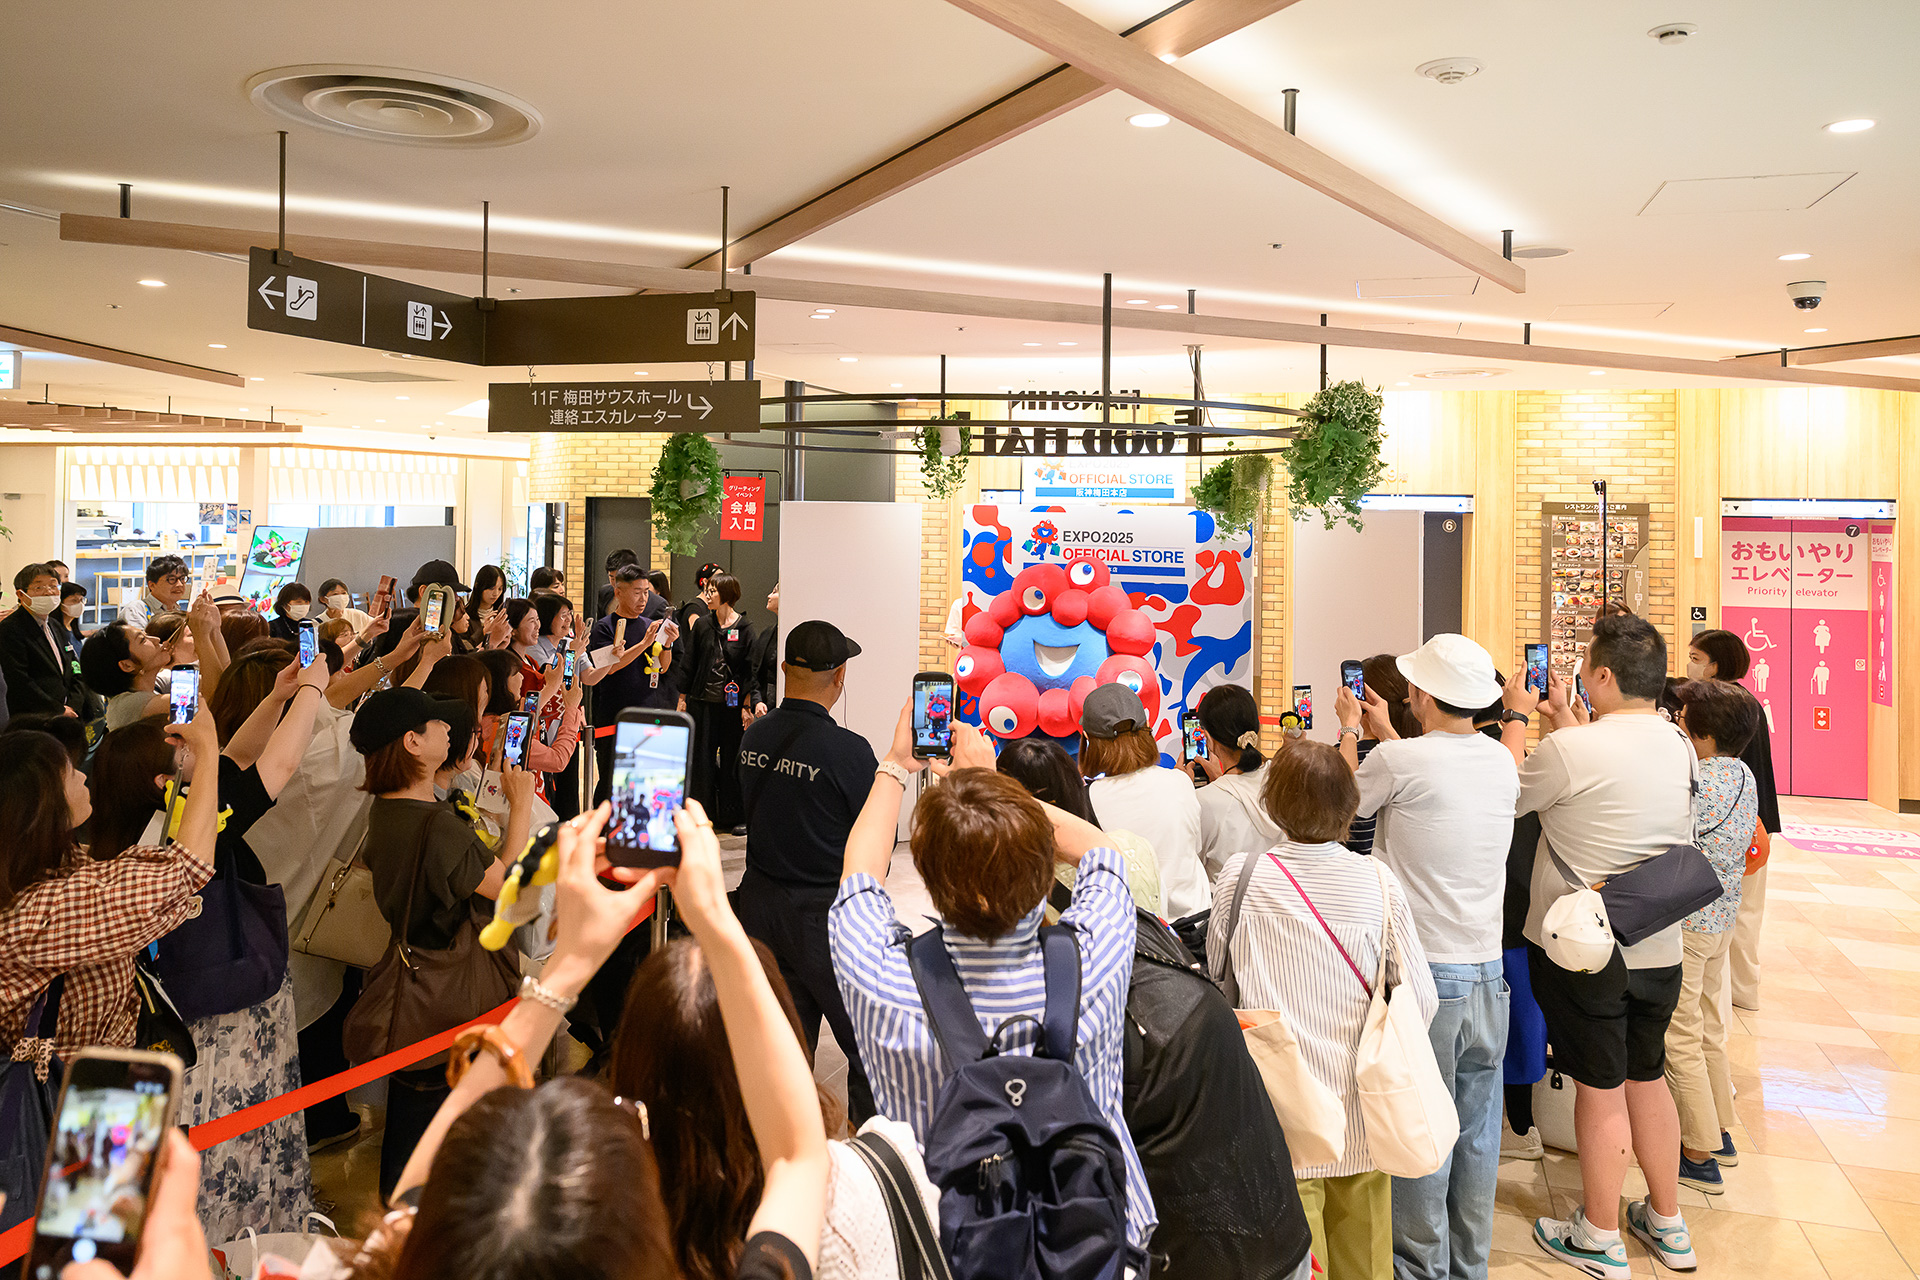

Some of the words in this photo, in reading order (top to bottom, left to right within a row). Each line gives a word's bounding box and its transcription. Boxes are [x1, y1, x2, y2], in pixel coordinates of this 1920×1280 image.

[531, 390, 558, 406] 11F
[563, 389, 682, 406] 梅田サウスホール
[549, 408, 682, 426] 連絡エスカレーター
[1069, 473, 1127, 484] OFFICIAL
[1129, 473, 1174, 485] STORE
[1075, 488, 1128, 498] 阪神梅田本店
[730, 500, 757, 516] 会場
[729, 517, 756, 531] 入口
[1445, 520, 1454, 532] 6
[1849, 526, 1858, 537] 7
[1063, 548, 1130, 562] OFFICIAL
[1132, 550, 1184, 564] STORE
[1731, 541, 1854, 563] おもいやり
[1731, 566, 1854, 584] エレベーター
[1747, 586, 1788, 598] Priority
[1795, 586, 1839, 598] elevator
